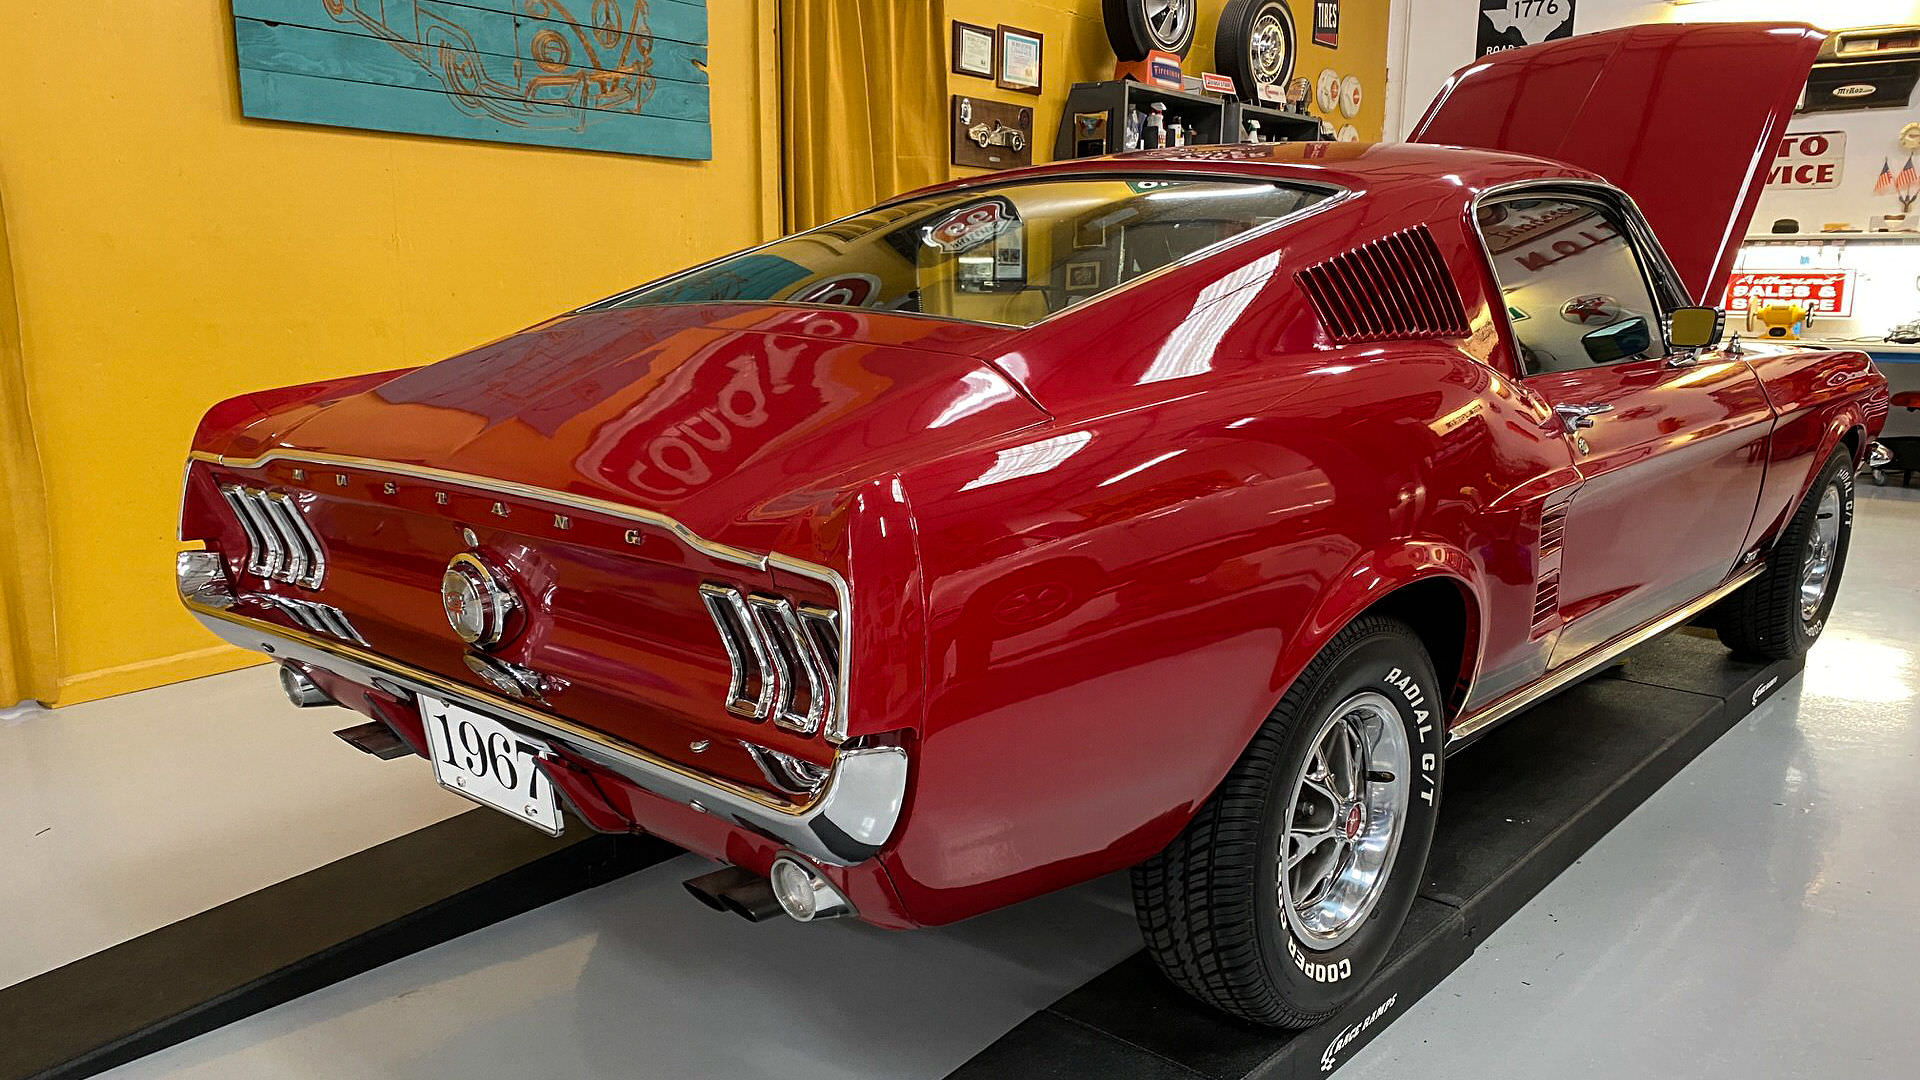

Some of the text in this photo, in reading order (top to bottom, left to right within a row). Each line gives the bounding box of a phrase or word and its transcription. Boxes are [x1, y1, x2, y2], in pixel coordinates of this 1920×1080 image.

[1318, 2, 1337, 28] TIRES
[1514, 0, 1558, 18] 1776
[1733, 285, 1836, 298] SALES &
[291, 467, 642, 547] MUSTANG
[433, 713, 541, 800] 1967
[1384, 667, 1437, 807] RADIAL G/T
[1287, 935, 1351, 983] COOPER
